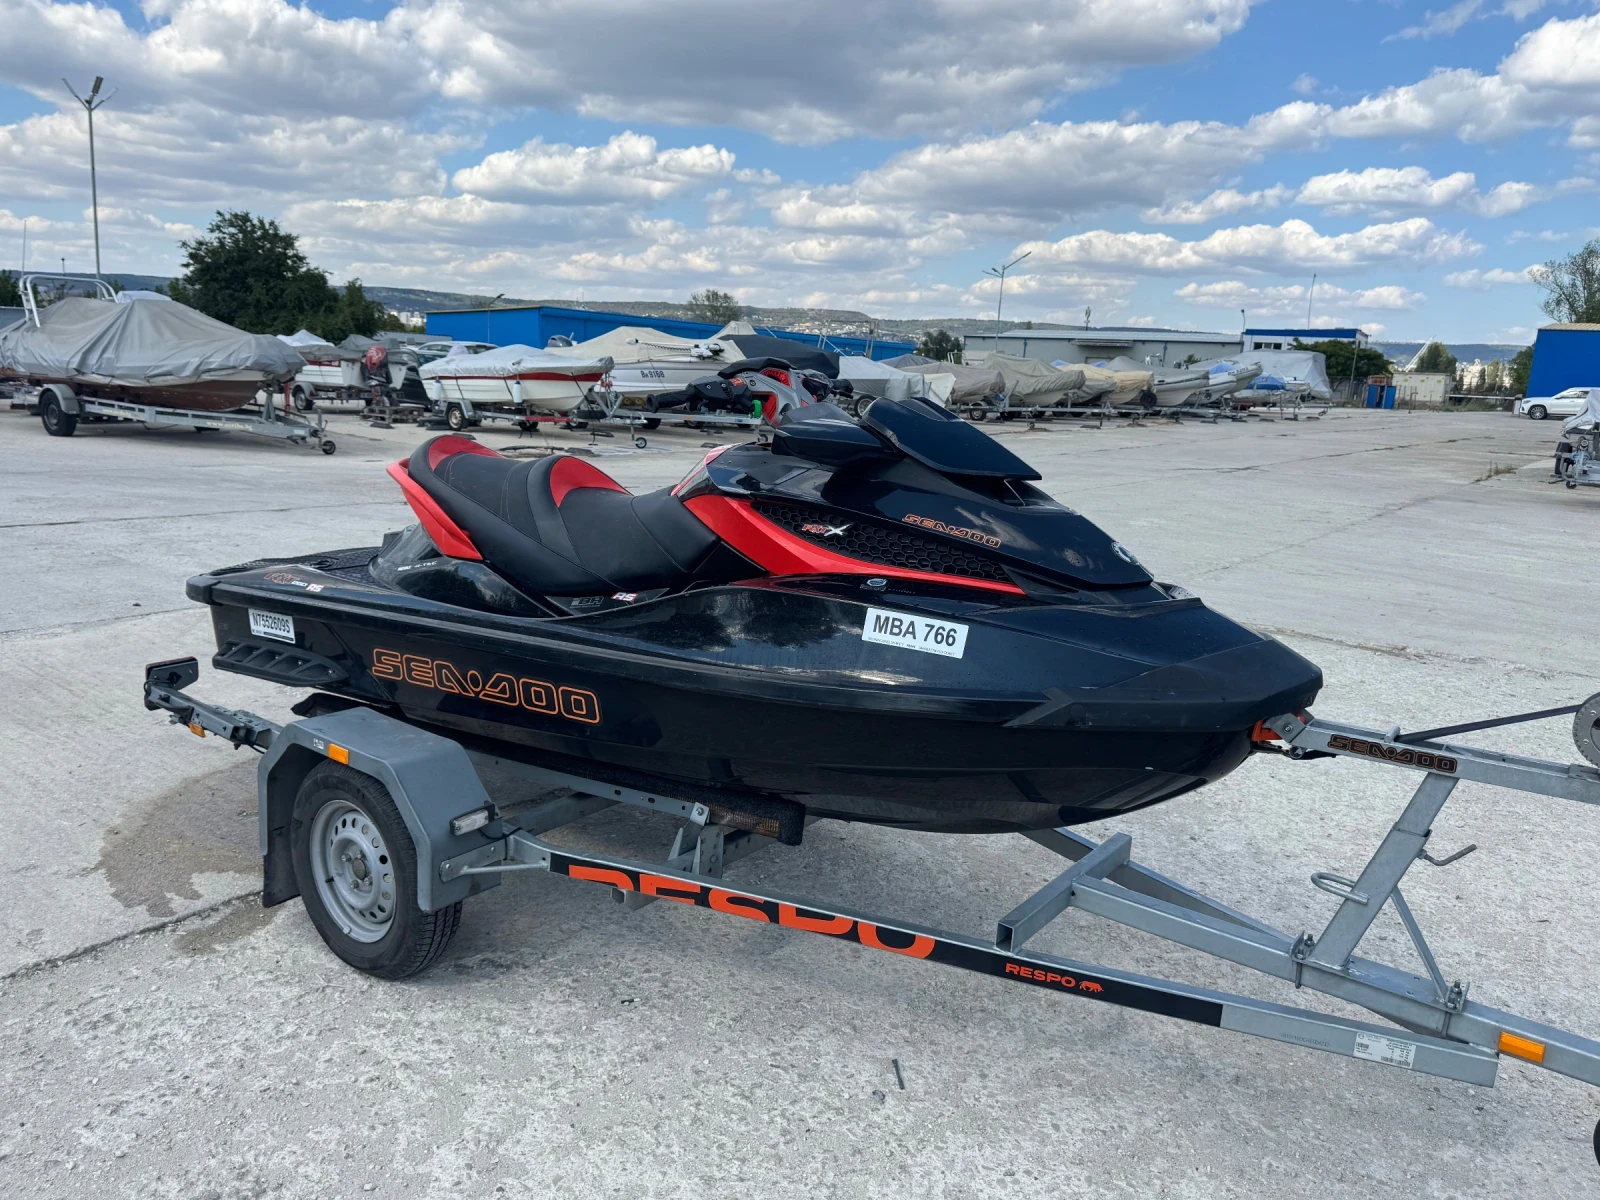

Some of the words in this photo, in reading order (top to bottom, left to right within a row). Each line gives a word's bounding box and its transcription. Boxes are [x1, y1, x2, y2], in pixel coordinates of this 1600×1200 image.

[873, 614, 917, 640] MBA
[923, 623, 957, 647] 766
[1005, 962, 1076, 988] RESPO
